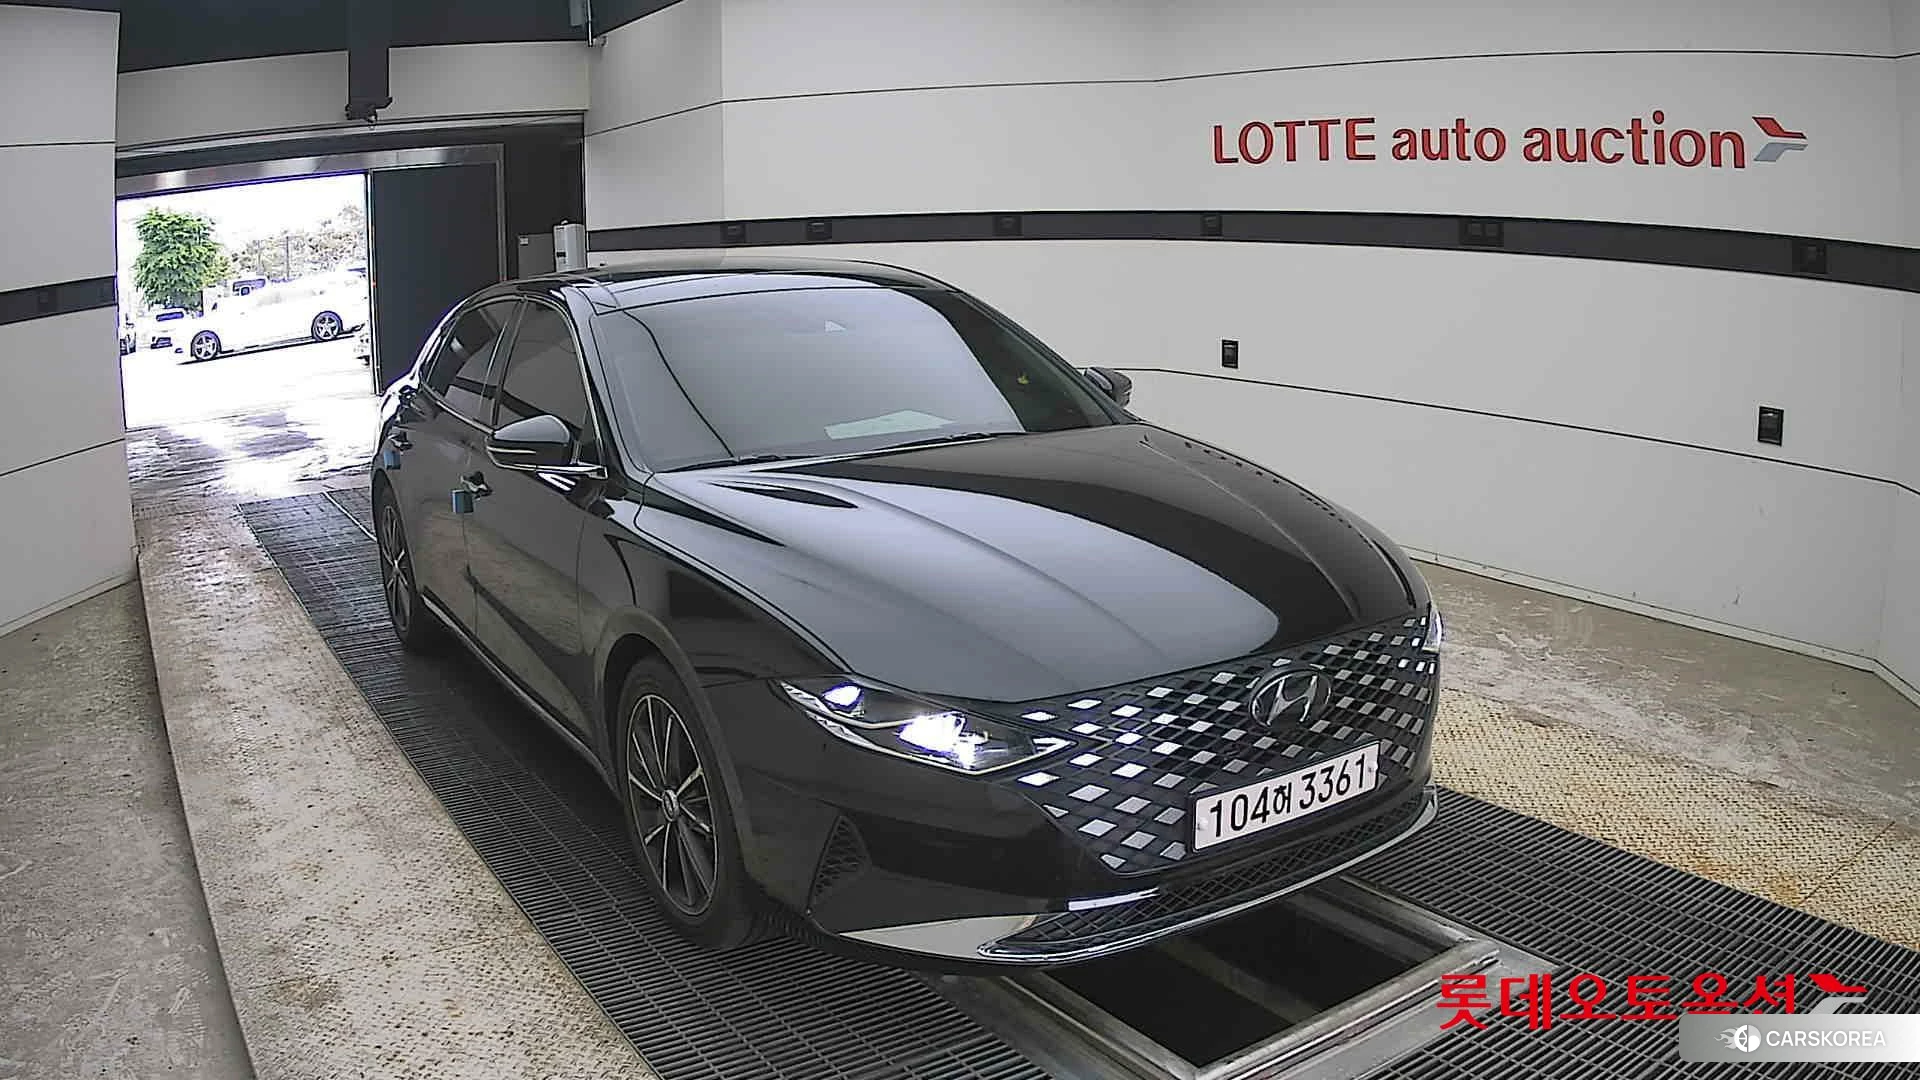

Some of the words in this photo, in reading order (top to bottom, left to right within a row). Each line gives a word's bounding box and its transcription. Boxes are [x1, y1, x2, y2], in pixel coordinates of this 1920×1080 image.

[1212, 117, 1377, 165] LOTTE
[1391, 118, 1508, 162] auto
[1522, 110, 1746, 169] auction
[1299, 753, 1366, 810] 3361
